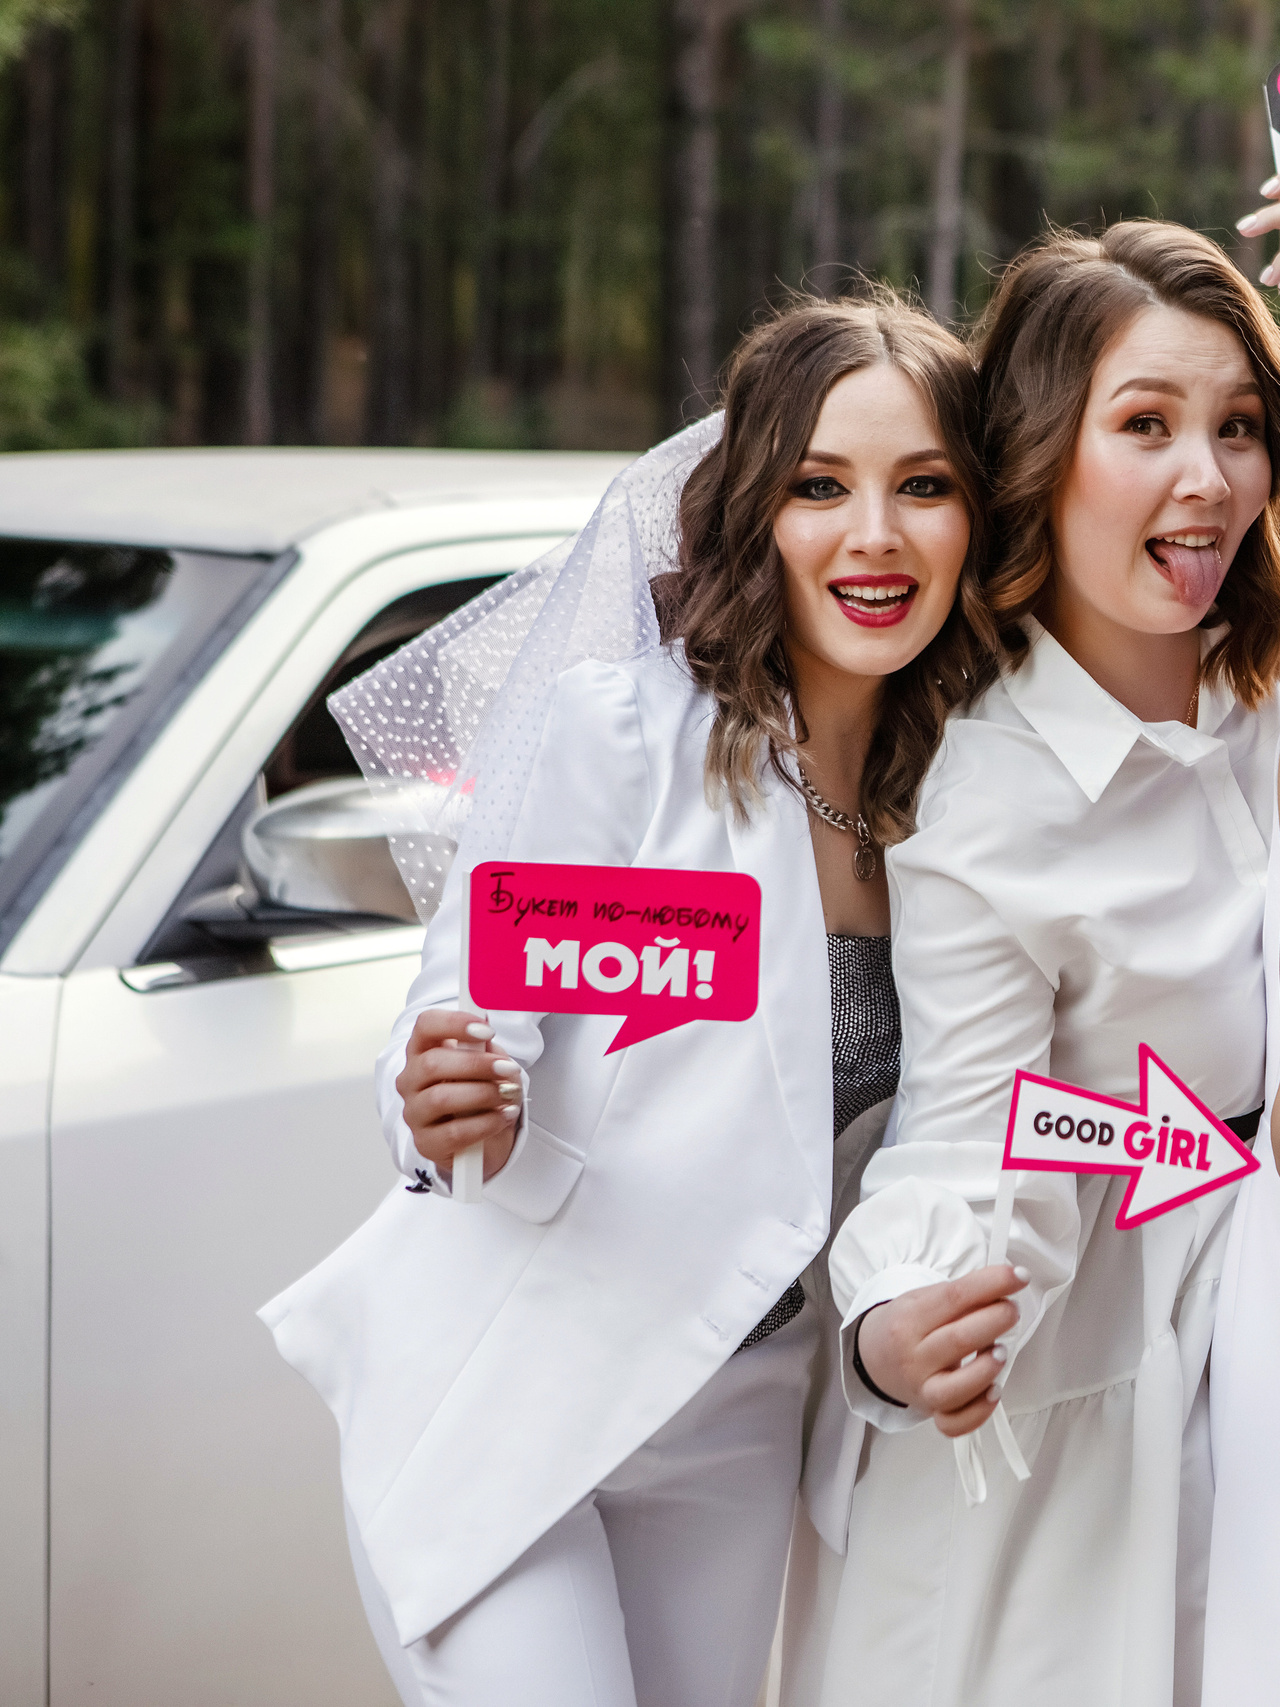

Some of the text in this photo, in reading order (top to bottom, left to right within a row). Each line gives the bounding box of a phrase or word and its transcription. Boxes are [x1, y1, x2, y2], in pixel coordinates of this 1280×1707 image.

[487, 871, 579, 928] Букет
[523, 935, 716, 1000] МОЙ!
[1033, 1110, 1115, 1147] GOOD
